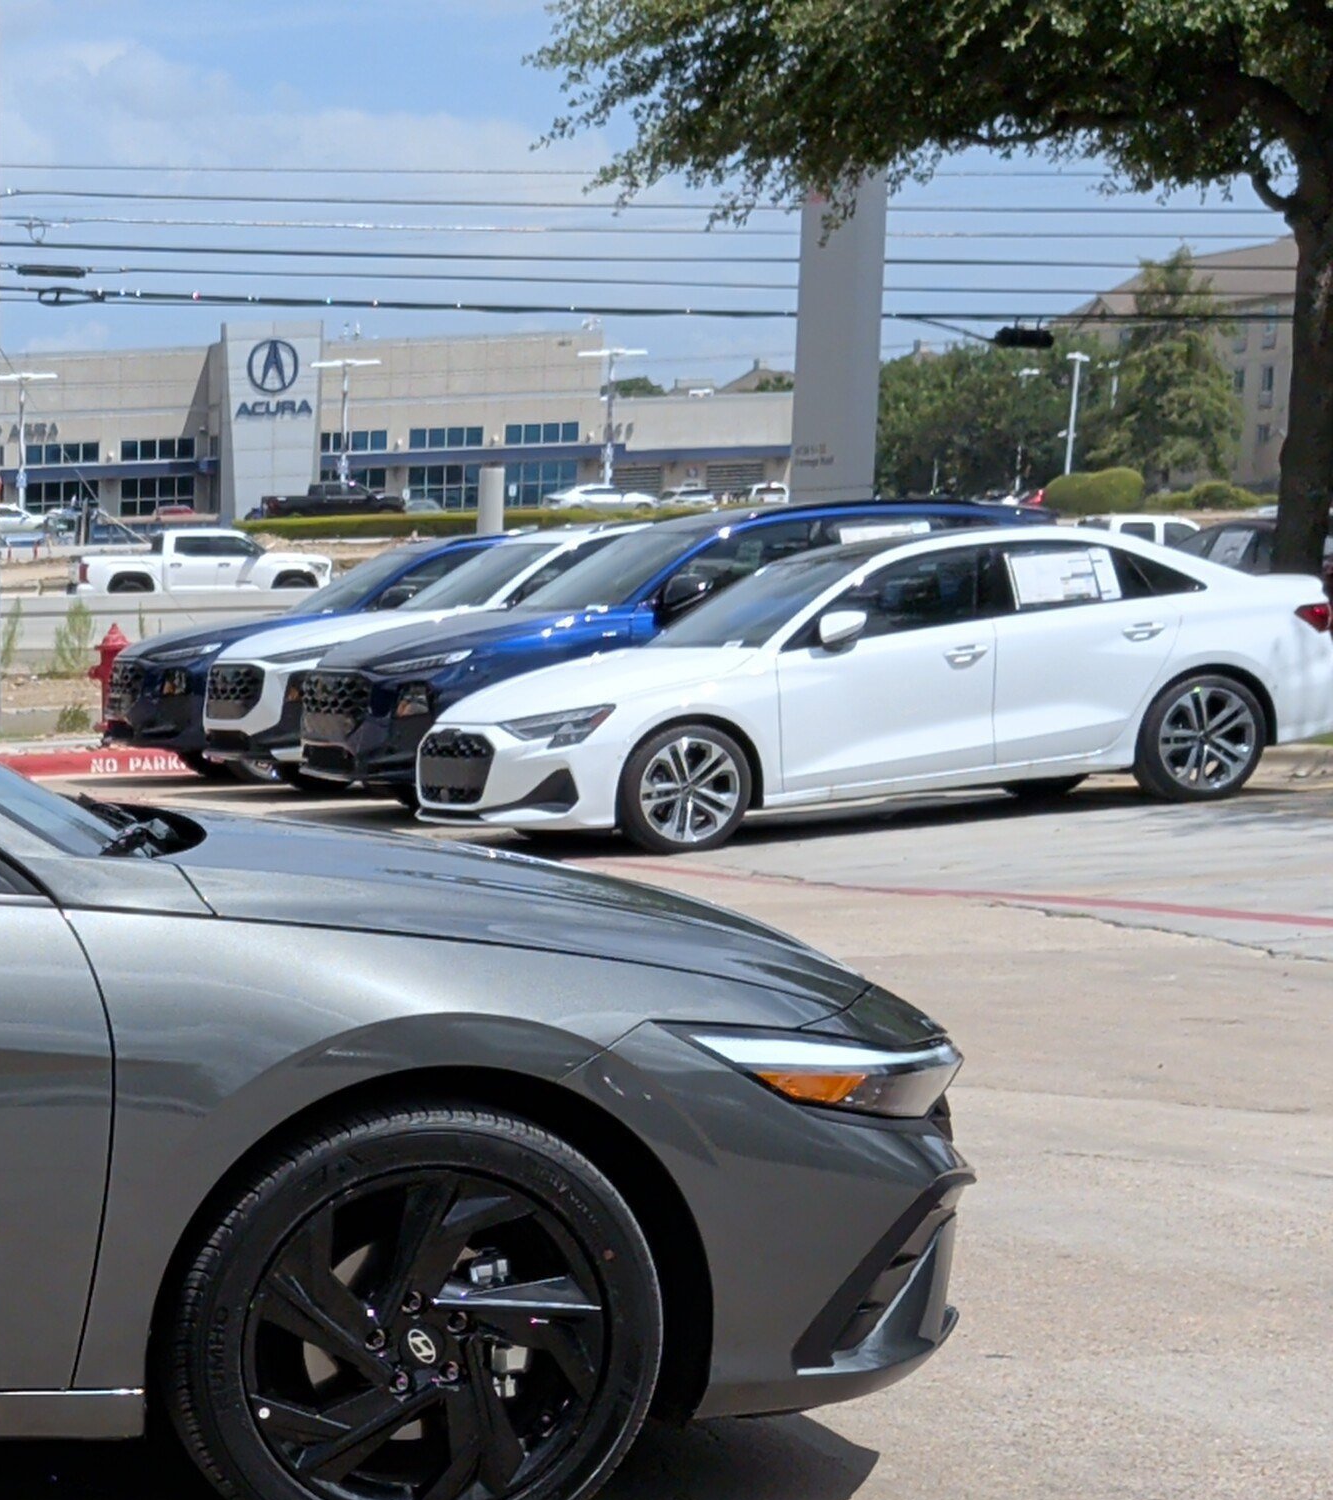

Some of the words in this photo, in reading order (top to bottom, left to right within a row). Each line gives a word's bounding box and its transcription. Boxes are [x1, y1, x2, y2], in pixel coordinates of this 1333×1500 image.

[235, 400, 312, 418] ACURA
[91, 757, 118, 773] NO
[129, 755, 187, 771] PARK
